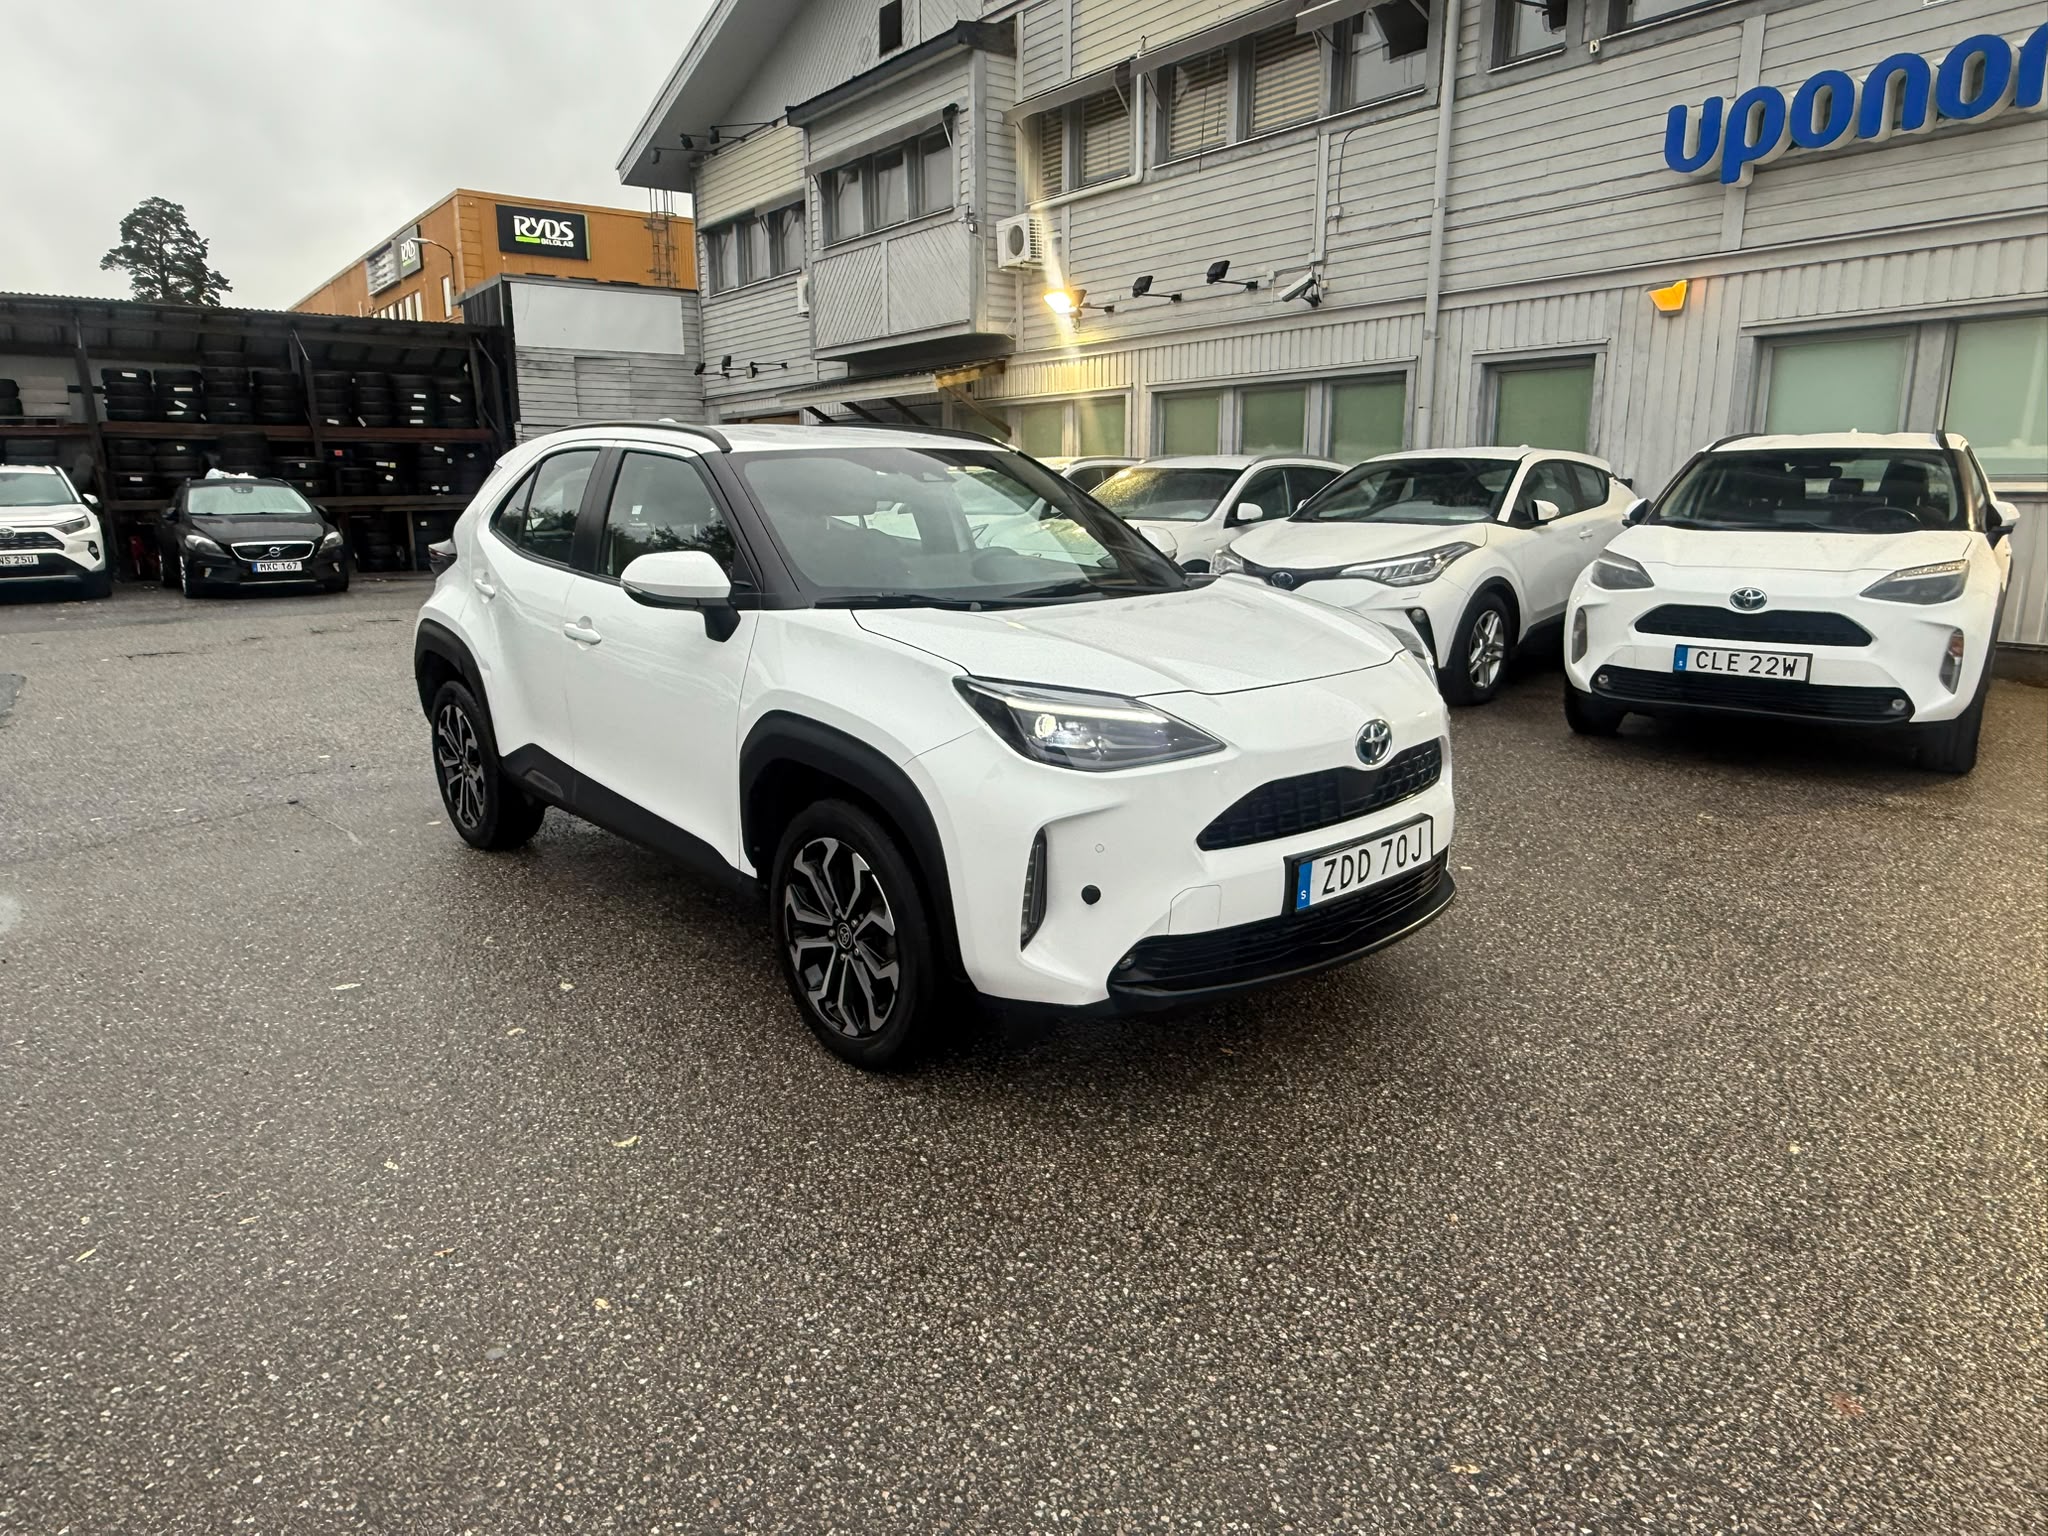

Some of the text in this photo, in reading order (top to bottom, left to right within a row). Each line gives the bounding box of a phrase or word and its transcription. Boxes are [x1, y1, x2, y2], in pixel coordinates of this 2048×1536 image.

[513, 215, 575, 241] RYDS
[260, 562, 298, 571] MXC 167
[1695, 651, 1798, 678] CLE 22W
[1322, 827, 1422, 896] ZDD 70J
[1300, 889, 1307, 900] S
